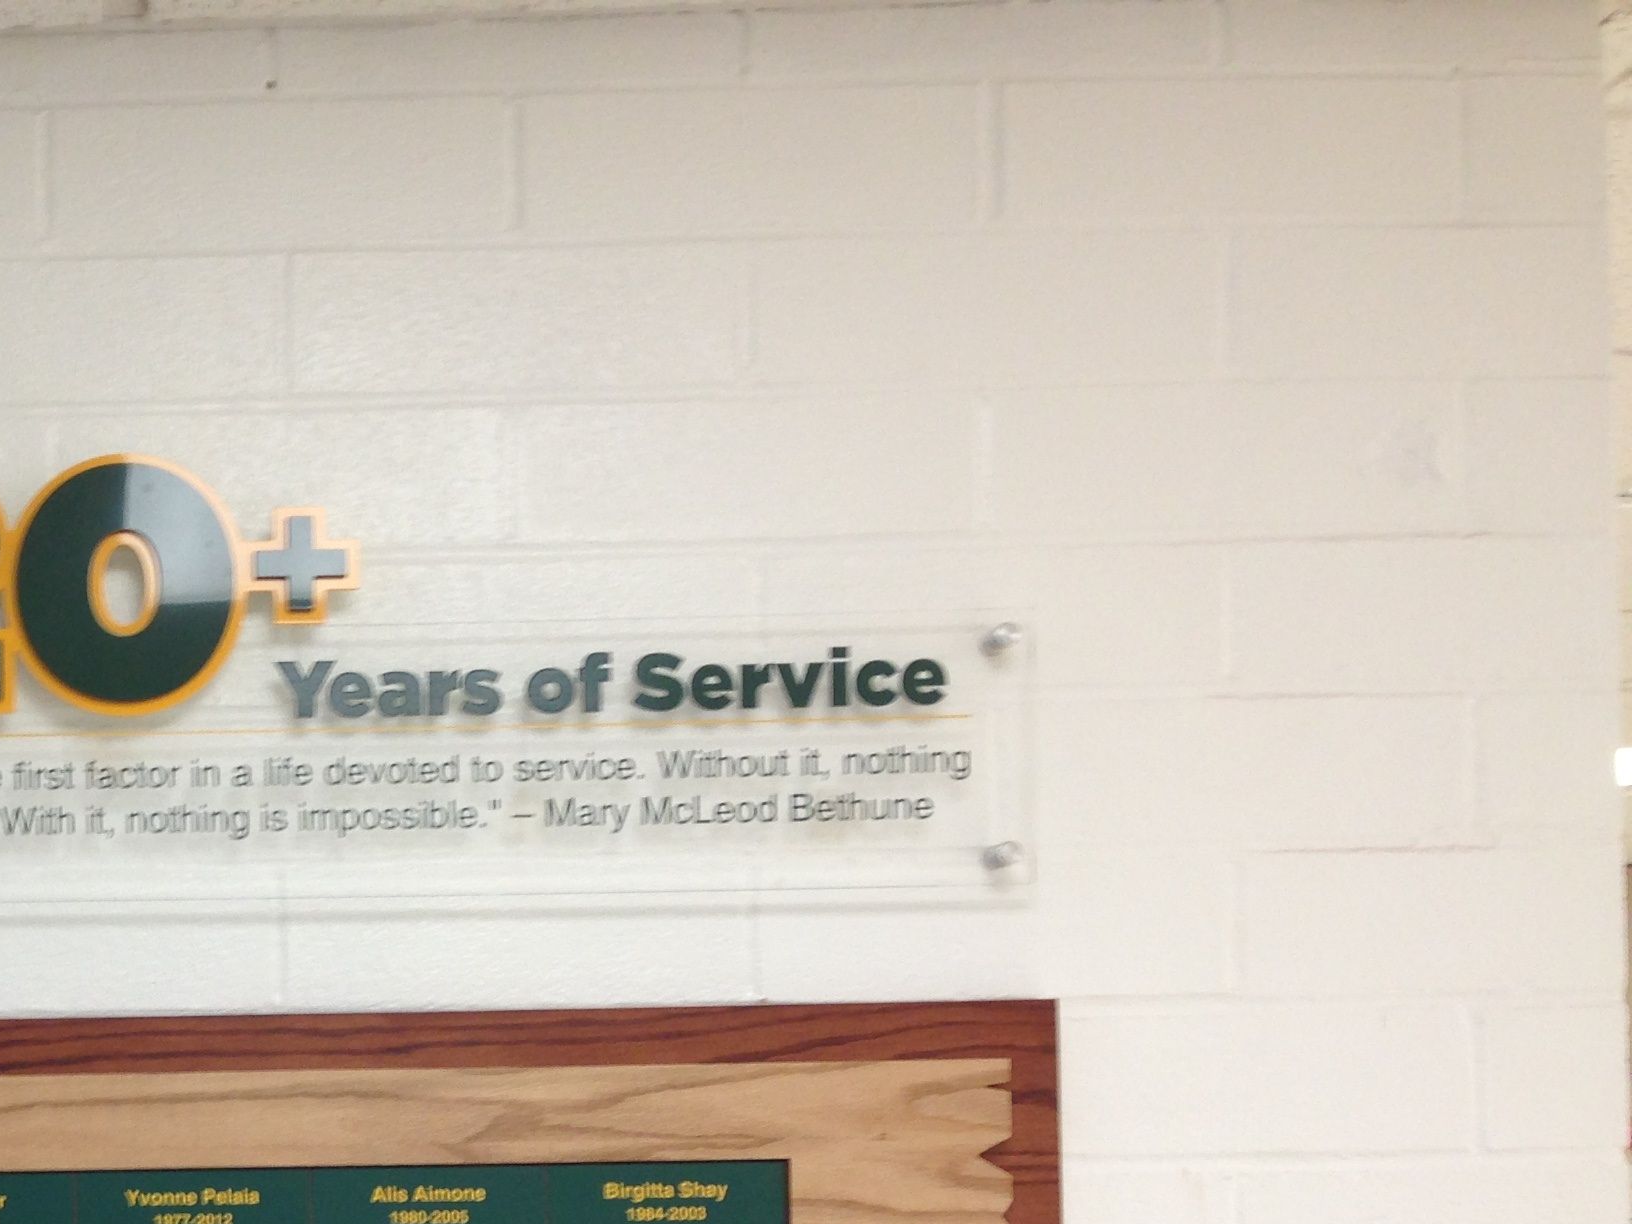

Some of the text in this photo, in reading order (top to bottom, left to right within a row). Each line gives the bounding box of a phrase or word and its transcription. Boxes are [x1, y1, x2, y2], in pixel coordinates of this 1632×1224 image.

[276, 646, 952, 720] Years of Service
[9, 760, 74, 792] first
[81, 759, 180, 791] factor
[186, 758, 223, 788] in
[228, 763, 256, 789] a
[261, 755, 315, 787] life
[320, 752, 463, 788] devoted
[469, 752, 506, 784] to
[510, 750, 648, 783] service.
[655, 748, 794, 781] Without
[798, 747, 833, 782] it,
[838, 745, 974, 781] nothing
[82, 801, 116, 838] it,
[123, 800, 252, 839] nothing
[258, 799, 289, 833] is
[542, 795, 632, 832] Mary
[638, 794, 779, 828] McLeod
[785, 791, 938, 826] Bethune
[126, 1190, 199, 1207] Yvonne
[370, 1185, 487, 1204] Alis Aimone
[602, 1180, 728, 1204] Birgitta Shay
